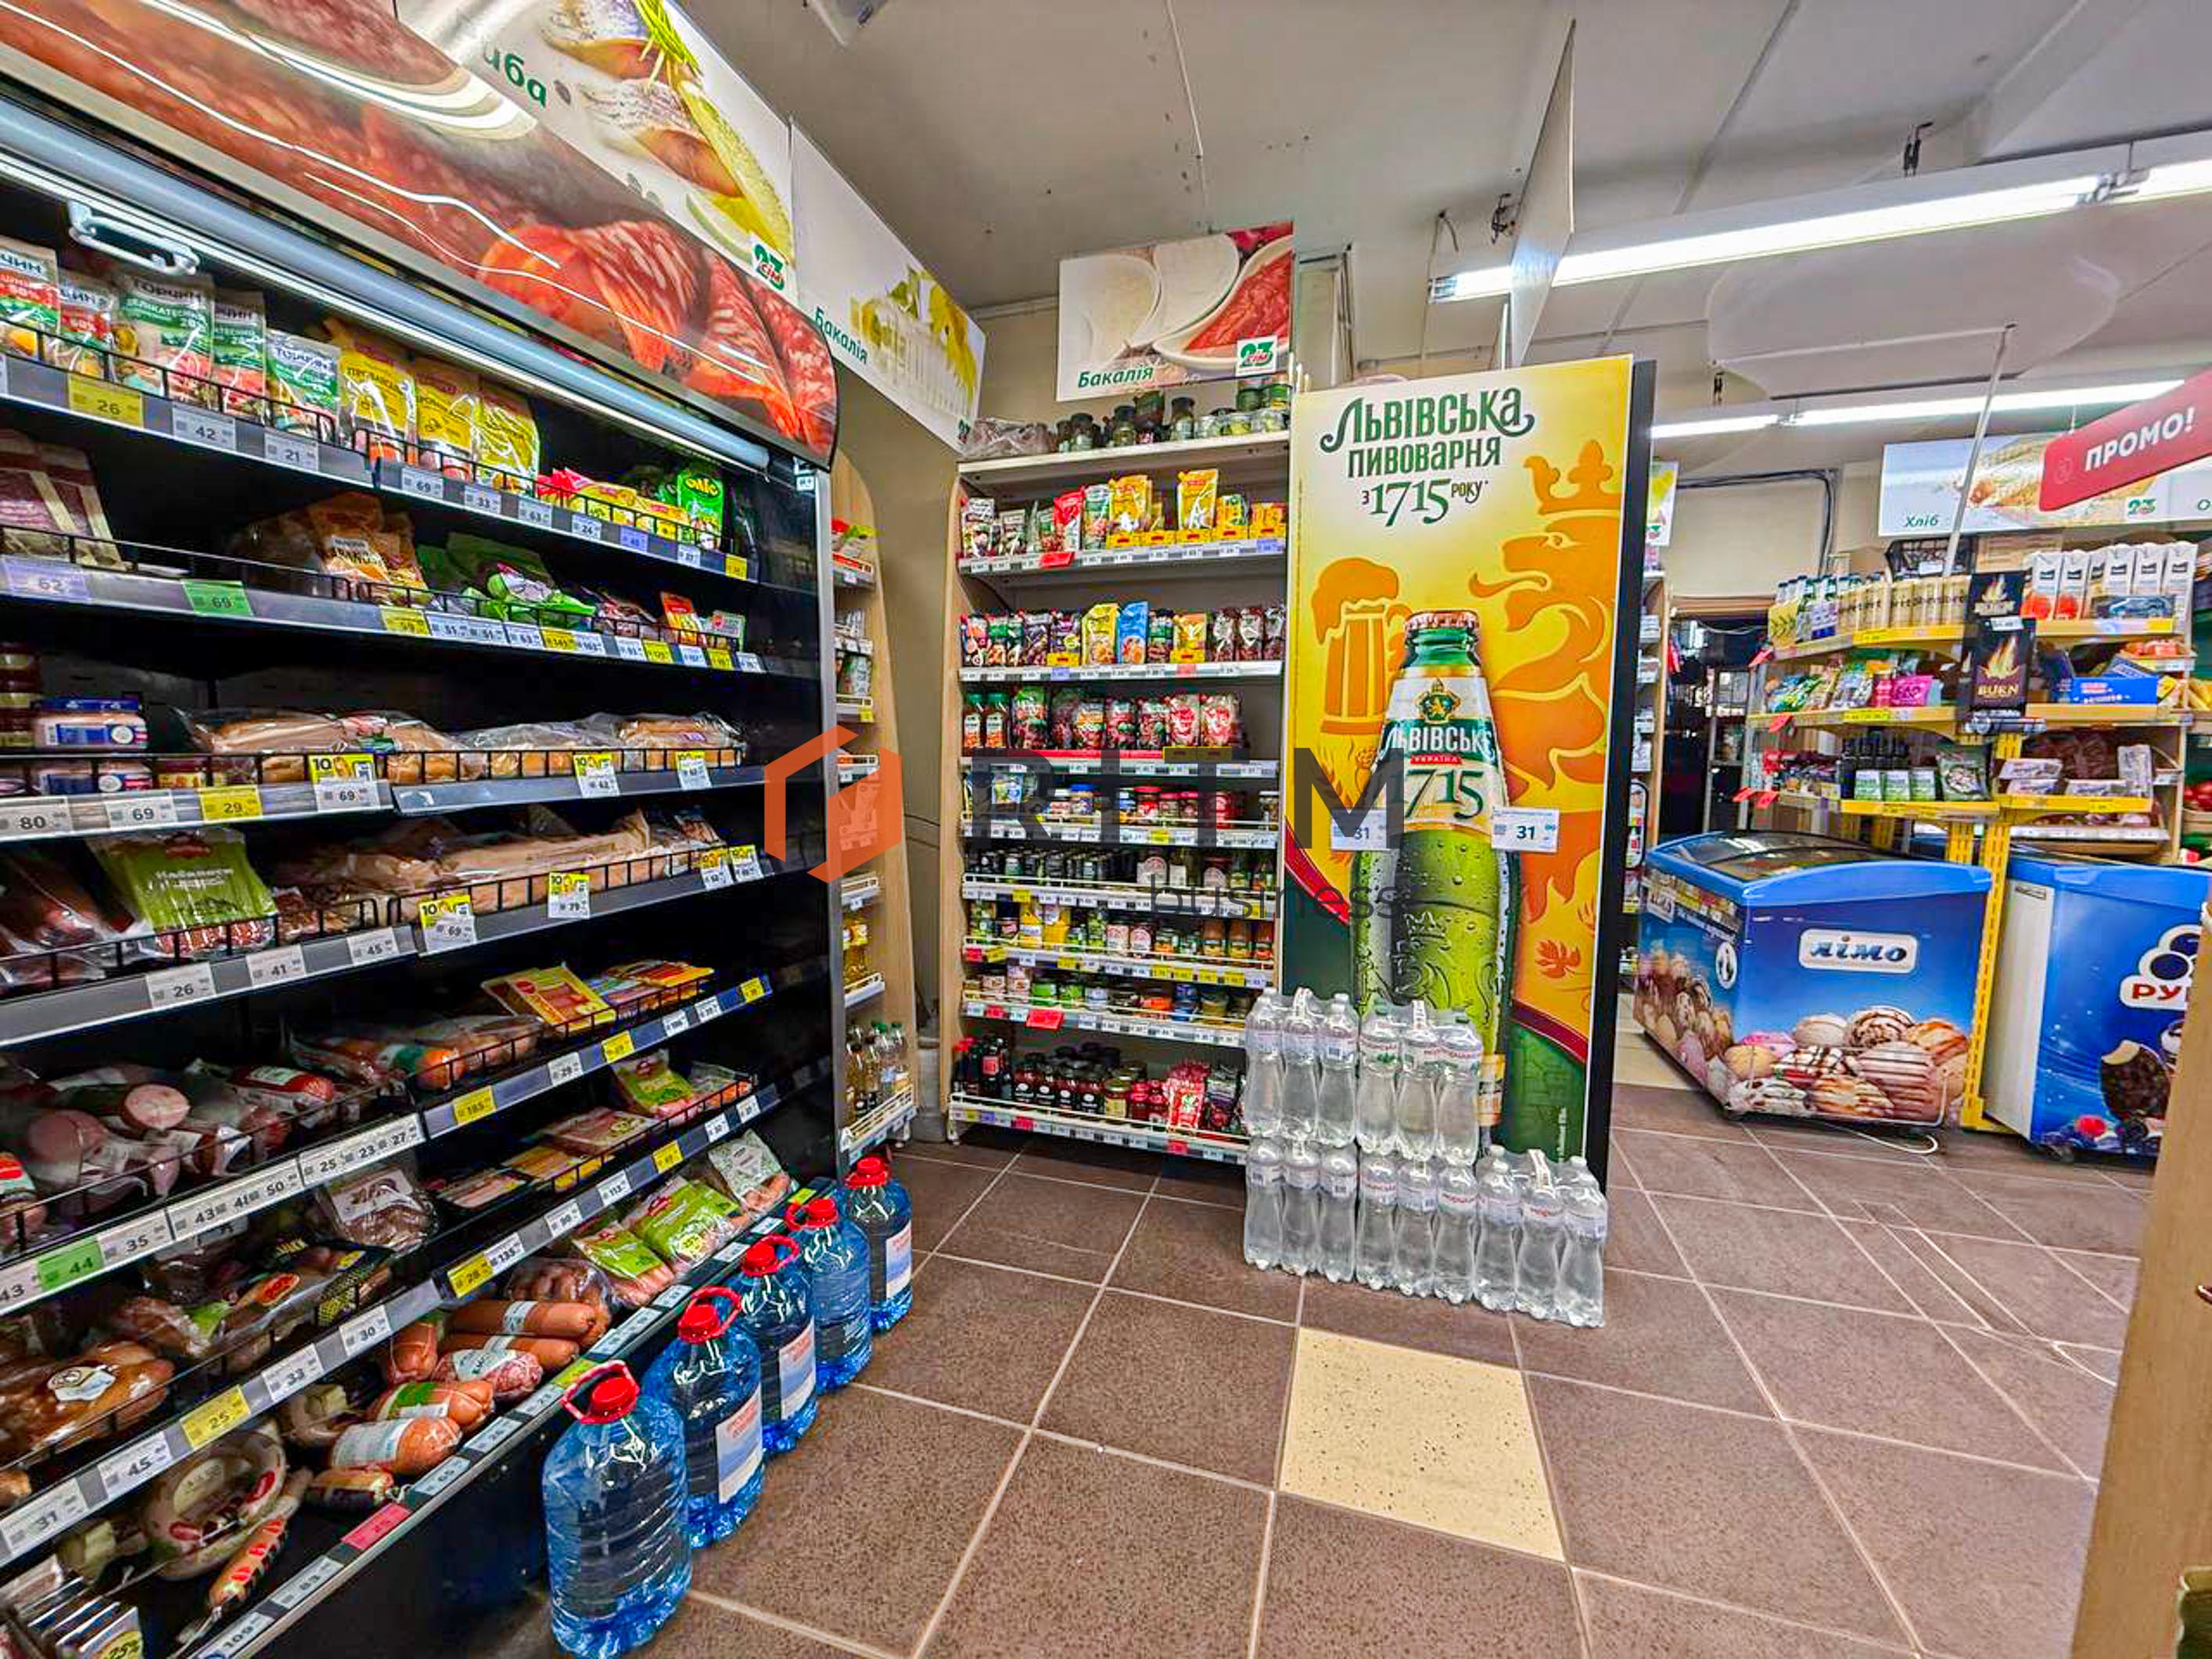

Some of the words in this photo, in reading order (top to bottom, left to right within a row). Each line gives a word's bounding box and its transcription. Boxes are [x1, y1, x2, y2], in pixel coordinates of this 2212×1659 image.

[813, 306, 868, 365] Бакалія
[1078, 366, 1154, 388] Бакалія
[97, 398, 120, 416] 26
[196, 426, 217, 441] 42
[2084, 407, 2196, 472] ПРОМО!
[285, 450, 300, 463] 21
[1370, 478, 1453, 527] 1715
[313, 758, 332, 771] 10
[132, 809, 154, 821] 69
[223, 803, 242, 813] 29
[20, 817, 46, 830] 80
[1516, 825, 1536, 840] 31
[551, 874, 562, 885] 10
[422, 904, 437, 915] 10
[368, 943, 382, 956] 45
[173, 984, 195, 999] 26
[390, 1133, 406, 1147] 27
[358, 1144, 376, 1158] 23
[319, 1158, 337, 1172] 25
[196, 1208, 215, 1223] 43
[124, 1236, 149, 1252] 35
[69, 1257, 94, 1274] 44
[359, 1327, 376, 1341] 30
[286, 1367, 305, 1384] 33
[208, 1411, 231, 1431] 25
[127, 1456, 153, 1476] 45
